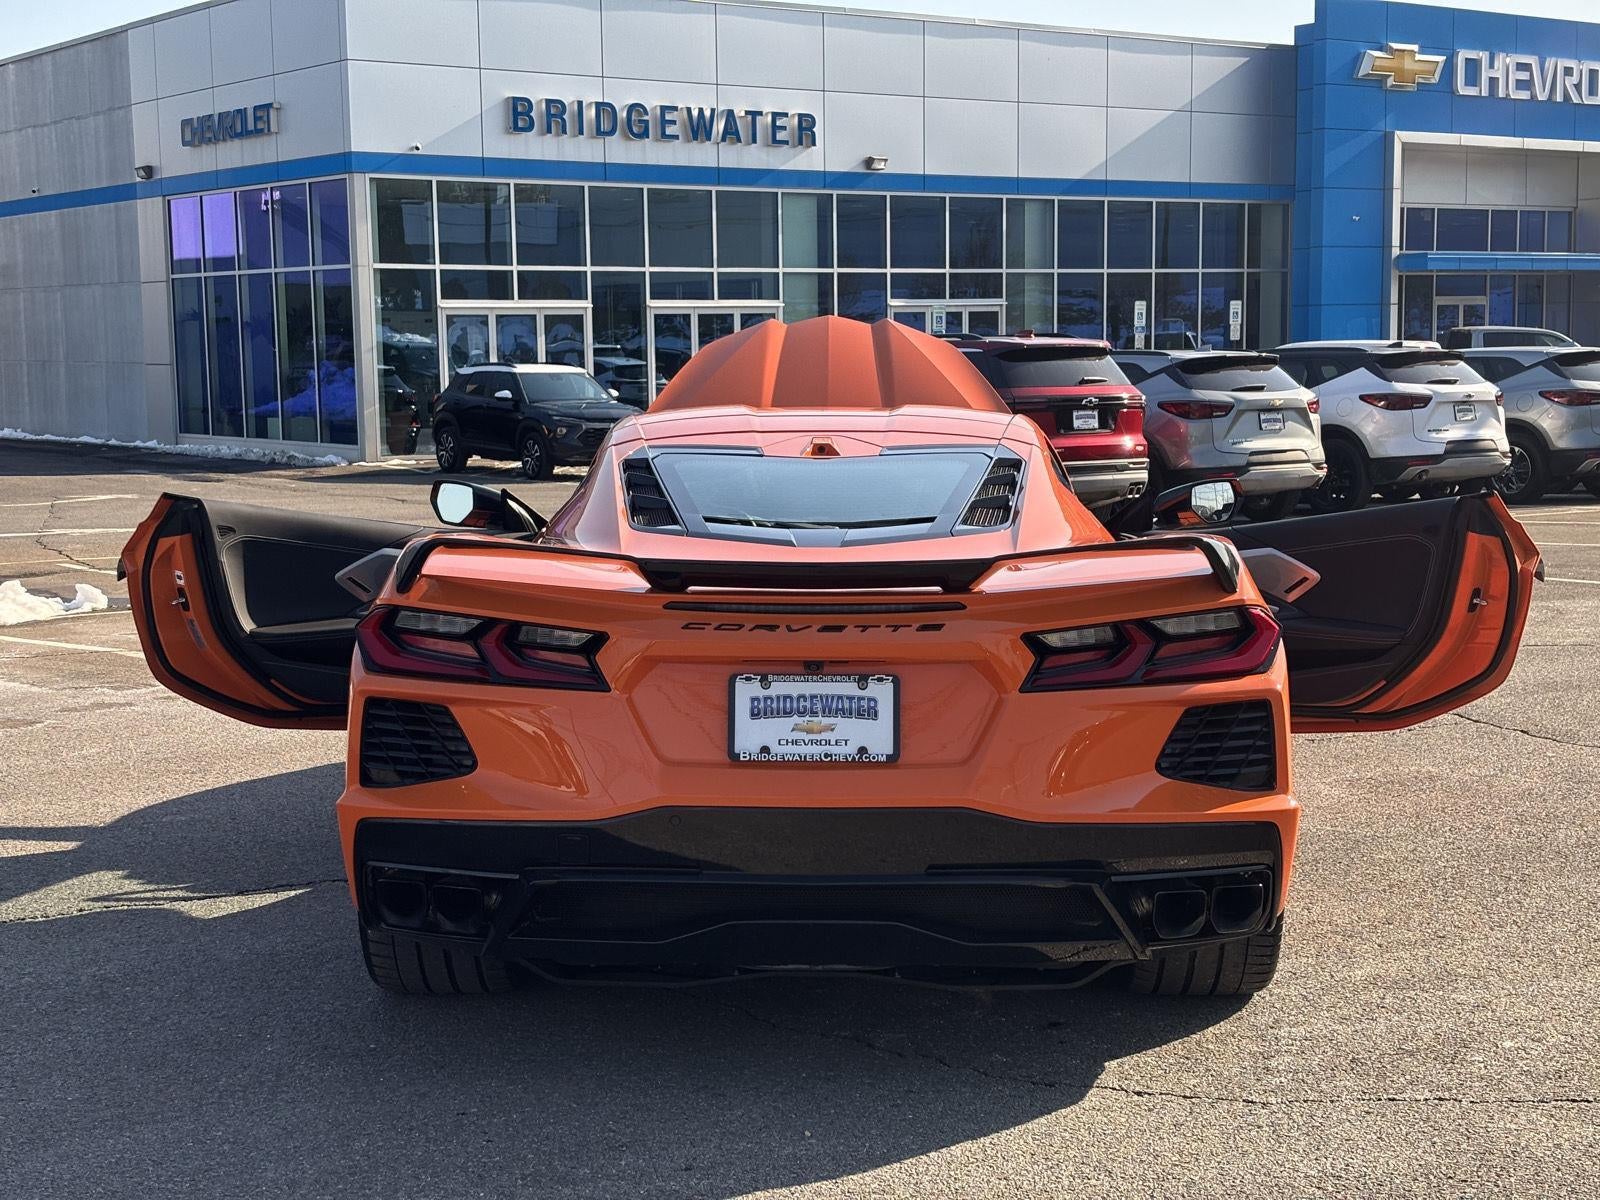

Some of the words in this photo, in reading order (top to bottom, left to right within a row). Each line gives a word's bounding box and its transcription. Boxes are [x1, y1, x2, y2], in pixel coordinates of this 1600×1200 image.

[1456, 49, 1600, 104] CHEVRO
[180, 102, 280, 147] CHEVROLET
[507, 95, 818, 148] BRIDGEWATER
[681, 622, 946, 633] CORVETTE
[750, 693, 880, 721] BRIDGEWATER
[777, 738, 851, 747] CHEVROLET
